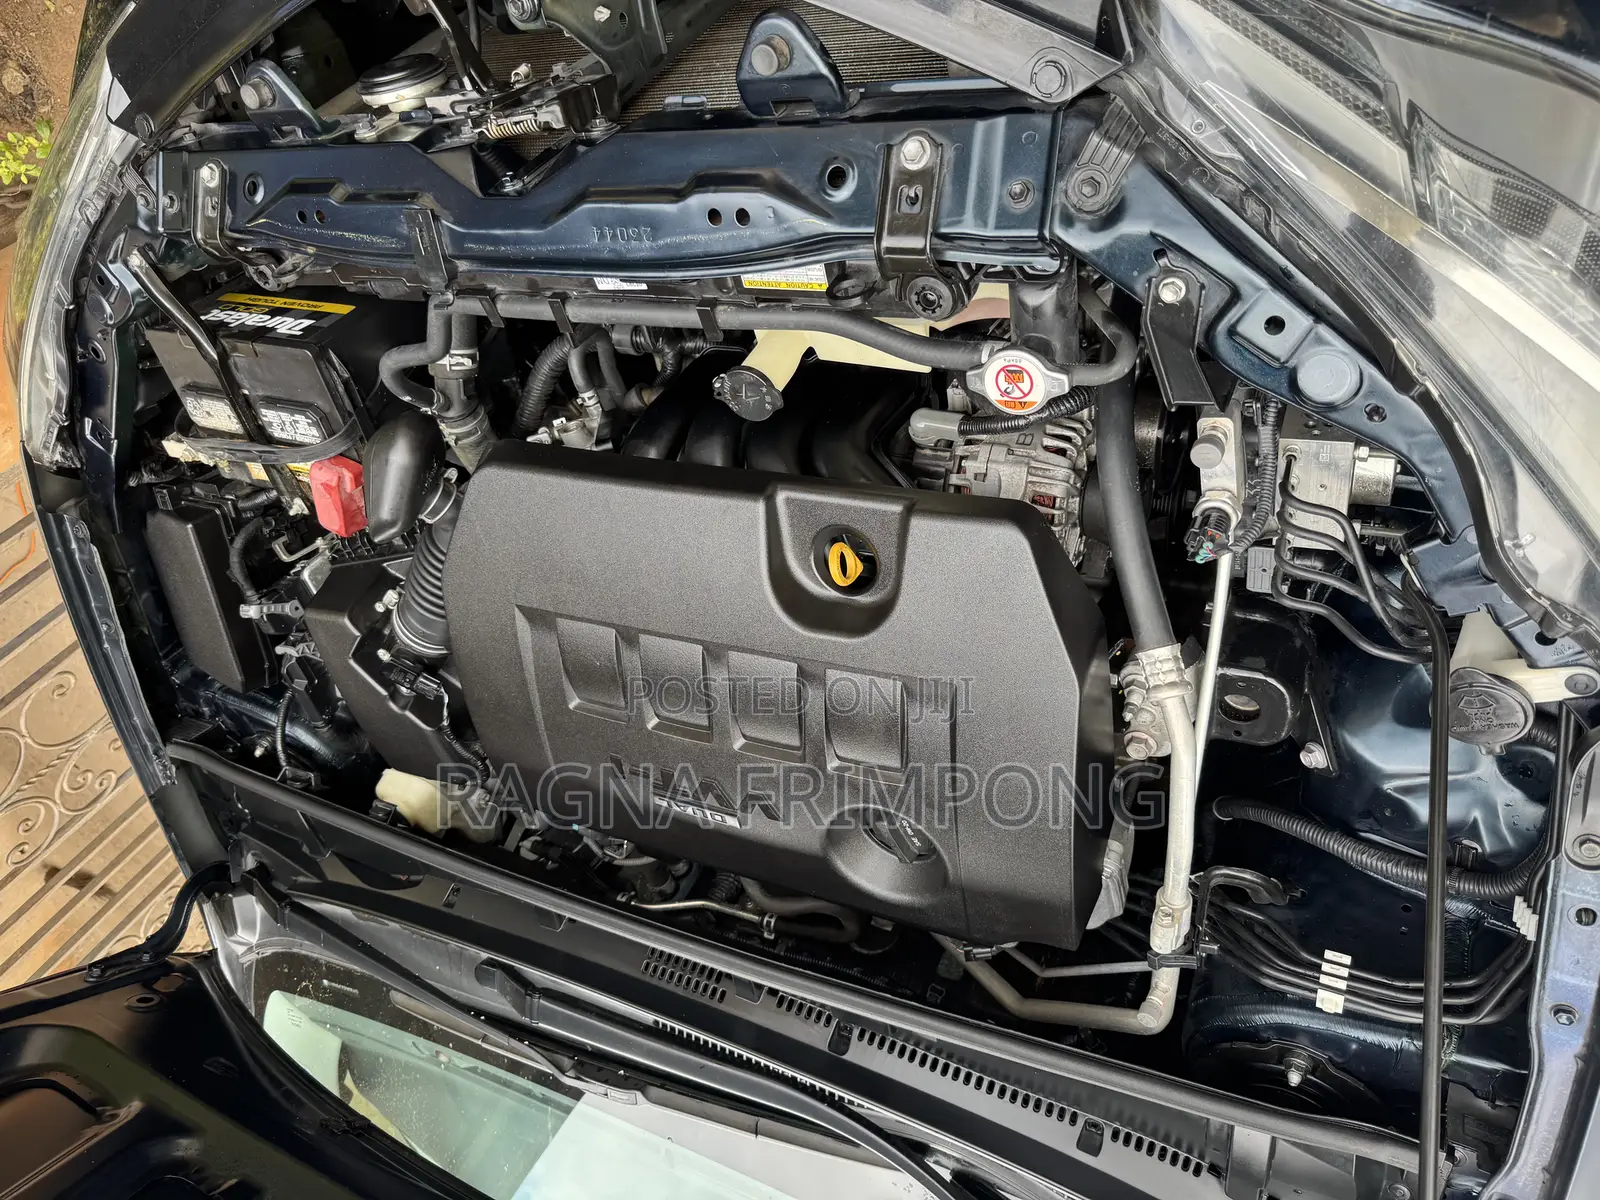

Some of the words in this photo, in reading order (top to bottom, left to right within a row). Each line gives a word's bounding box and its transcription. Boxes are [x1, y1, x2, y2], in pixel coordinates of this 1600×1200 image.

[592, 226, 652, 244] 23044
[748, 280, 781, 288] ATTENTION
[786, 282, 814, 290] CAUTION
[245, 296, 279, 304] TOUGH
[218, 304, 269, 313] GOLD
[280, 301, 324, 309] PROVEN
[200, 308, 317, 336] Duralast
[1470, 717, 1494, 725] ONLY
[1450, 724, 1476, 733] FLUID
[1482, 722, 1520, 731] WASHER
[657, 797, 728, 825] DUAL
